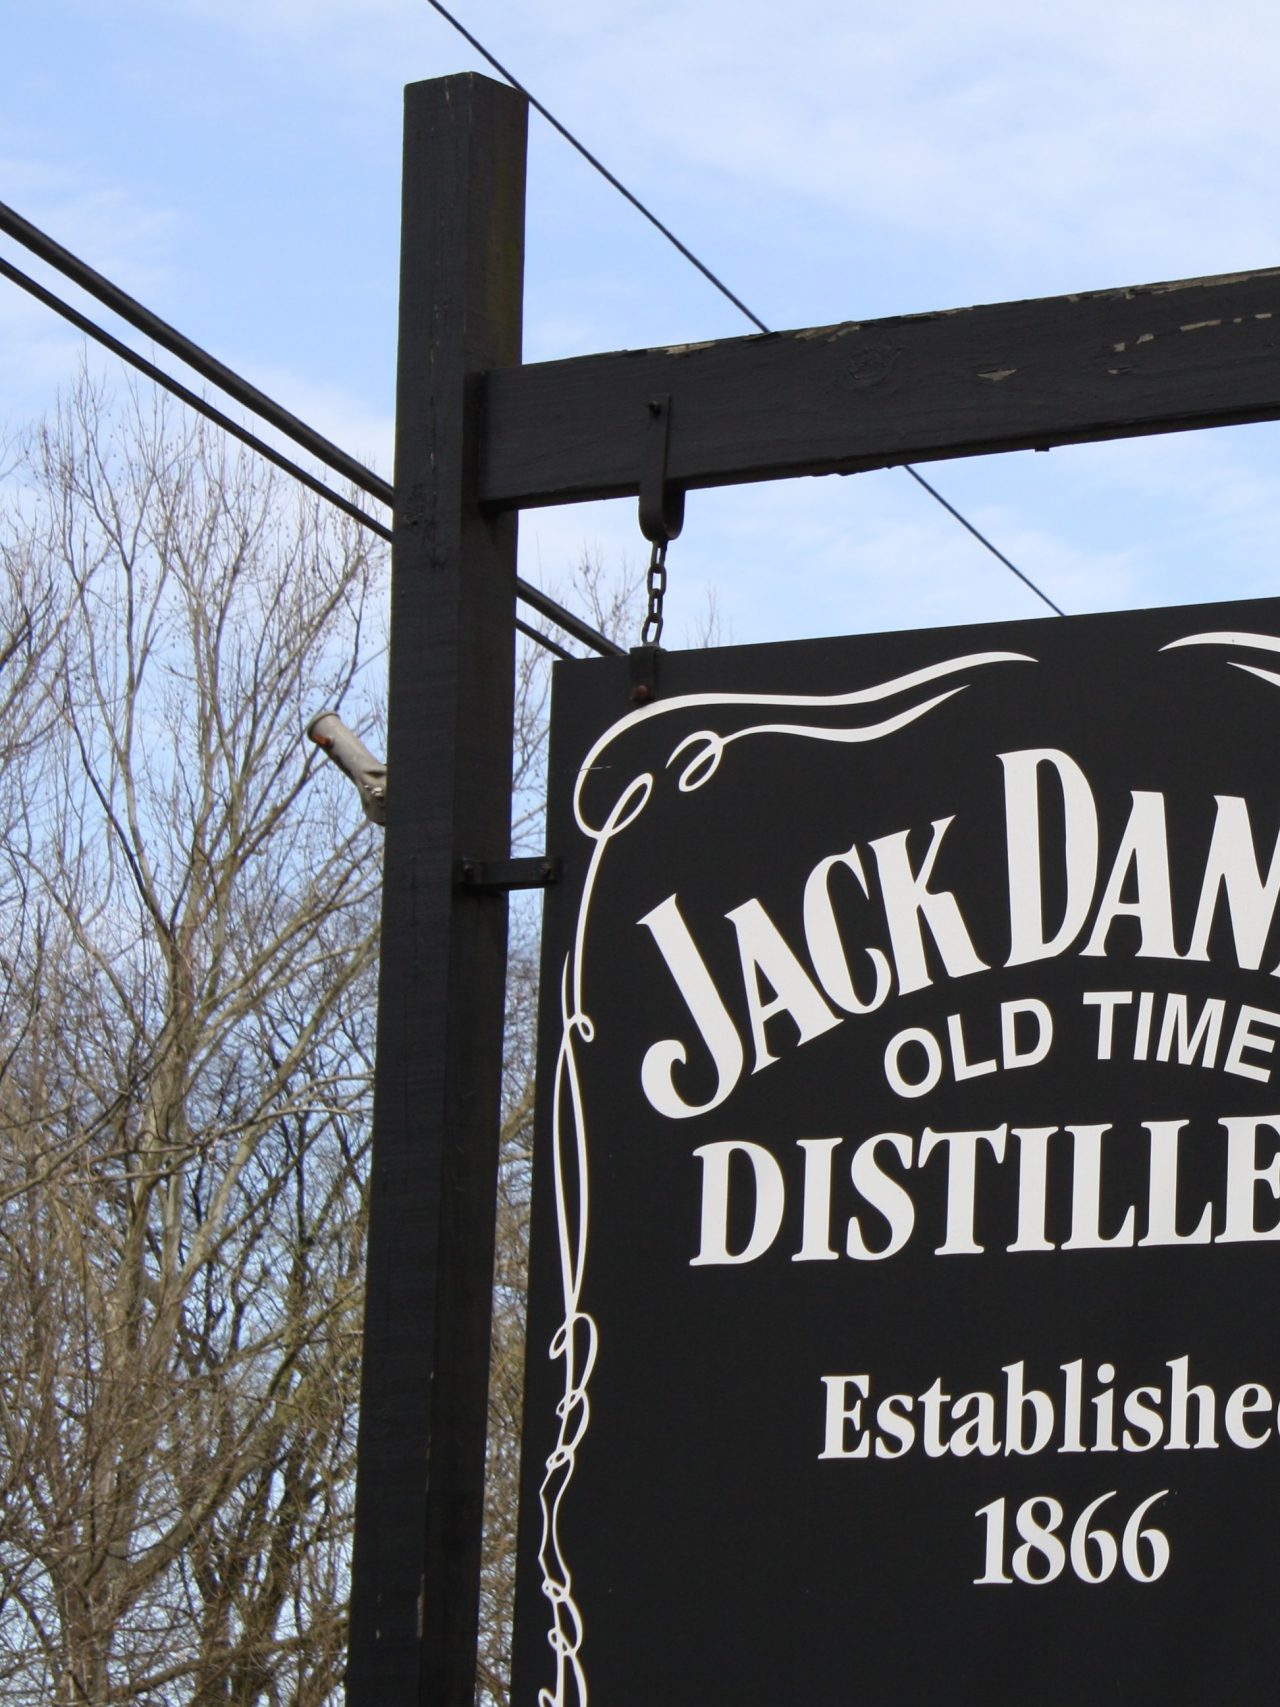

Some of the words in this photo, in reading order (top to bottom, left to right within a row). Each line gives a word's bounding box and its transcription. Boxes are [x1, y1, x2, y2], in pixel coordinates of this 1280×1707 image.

[637, 815, 991, 1119] JACK
[884, 998, 1054, 1099] OLD
[973, 1489, 1171, 1585] 1866
